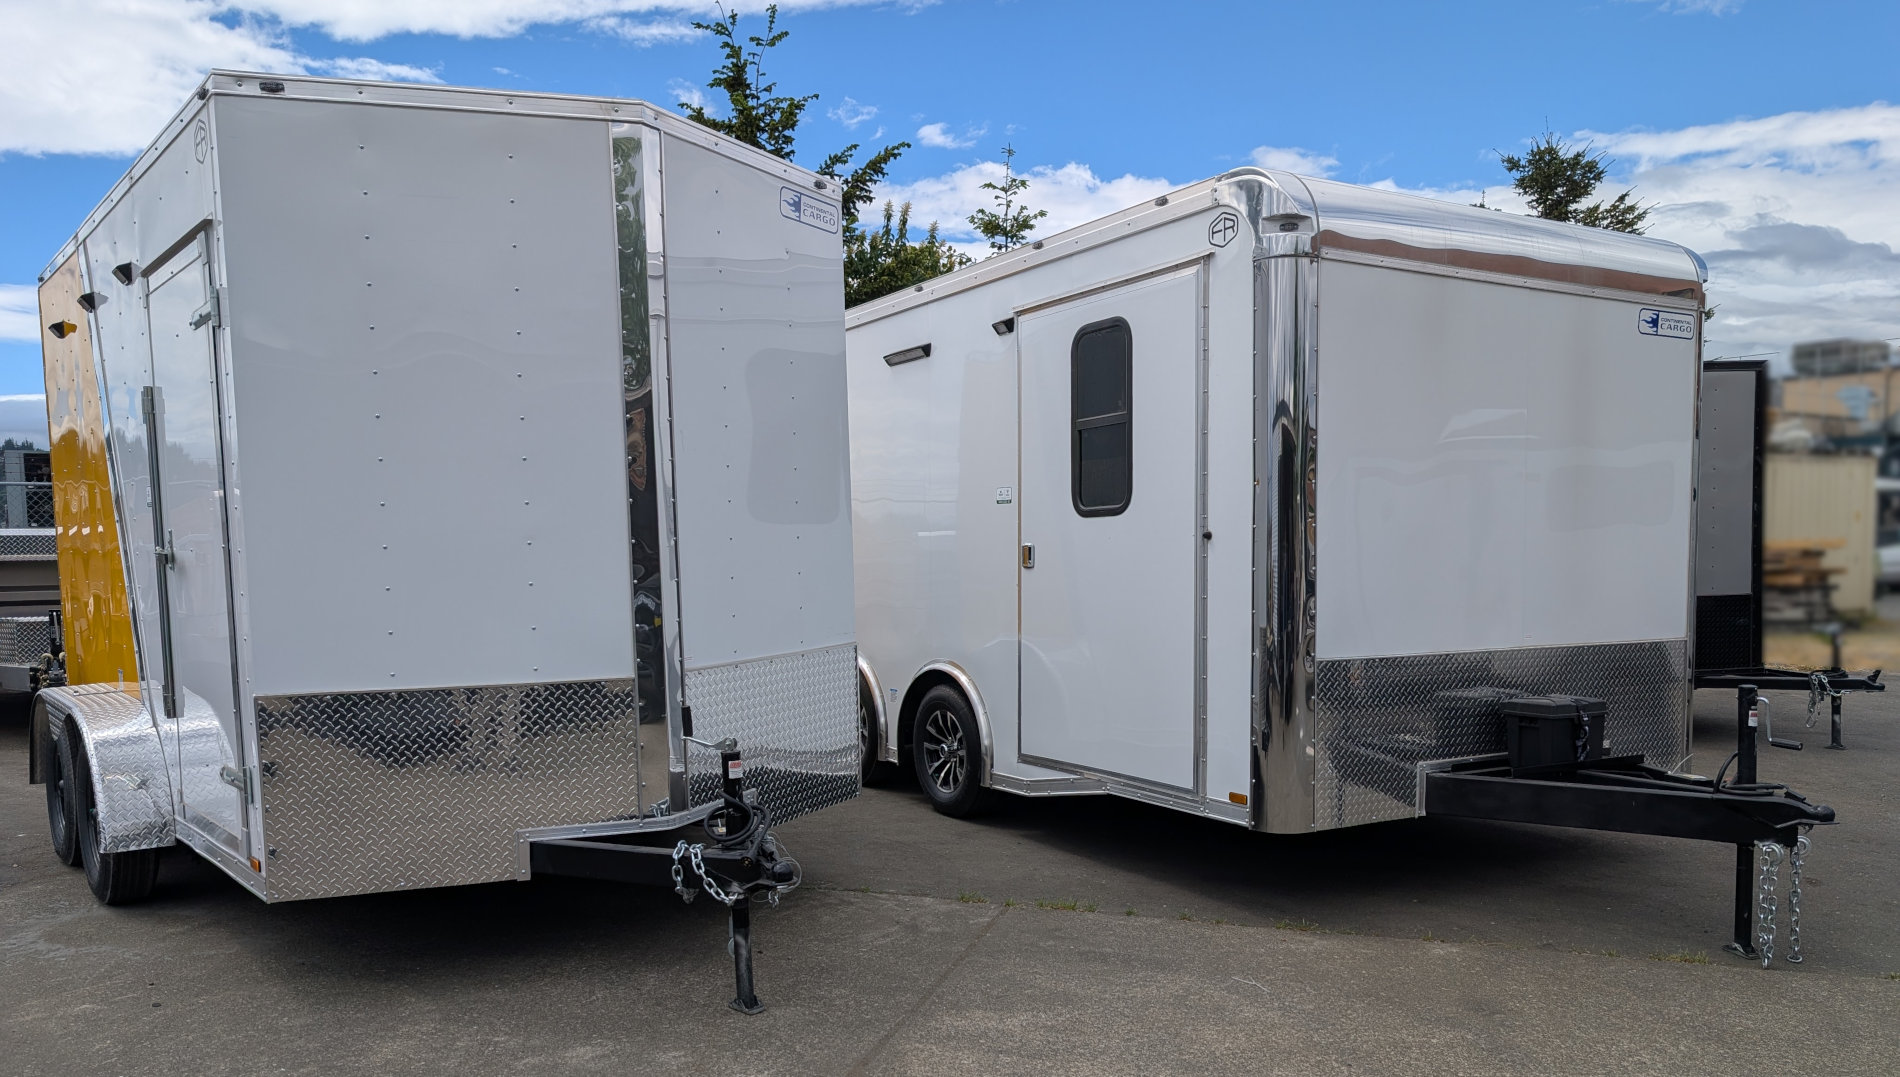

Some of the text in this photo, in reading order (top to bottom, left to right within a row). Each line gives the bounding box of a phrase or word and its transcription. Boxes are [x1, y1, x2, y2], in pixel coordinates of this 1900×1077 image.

[803, 202, 835, 217] CONTINENTAL
[803, 209, 835, 226] CARGO
[1661, 323, 1691, 333] CARGO
